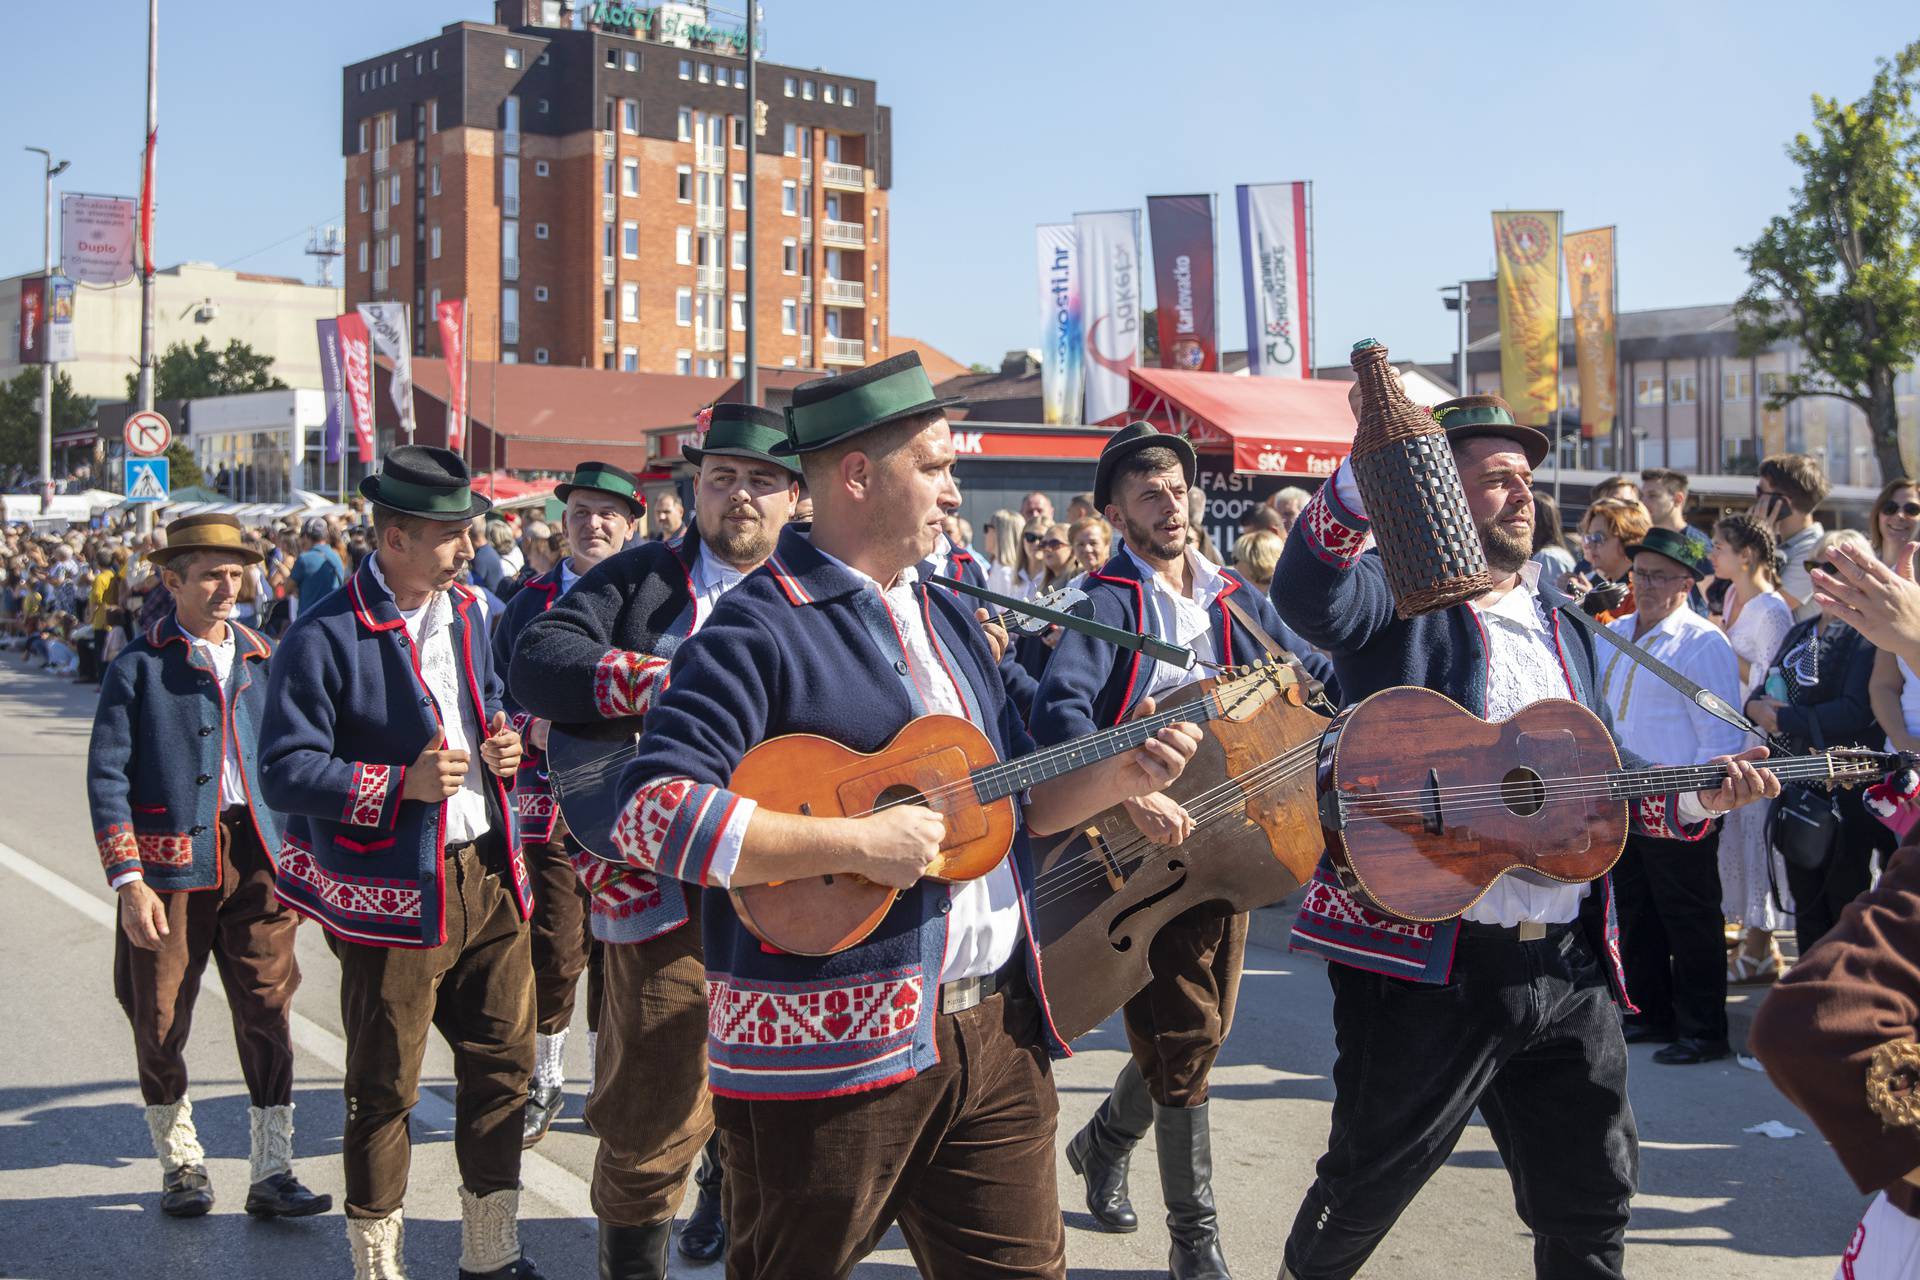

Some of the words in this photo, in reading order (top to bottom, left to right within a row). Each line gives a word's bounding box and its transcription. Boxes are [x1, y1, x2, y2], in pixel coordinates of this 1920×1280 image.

[78, 241, 117, 254] Duplo
[1173, 255, 1195, 334] Karlovačko
[1306, 454, 1338, 474] fast
[1199, 471, 1257, 492] FAST
[1202, 525, 1244, 552] HI
